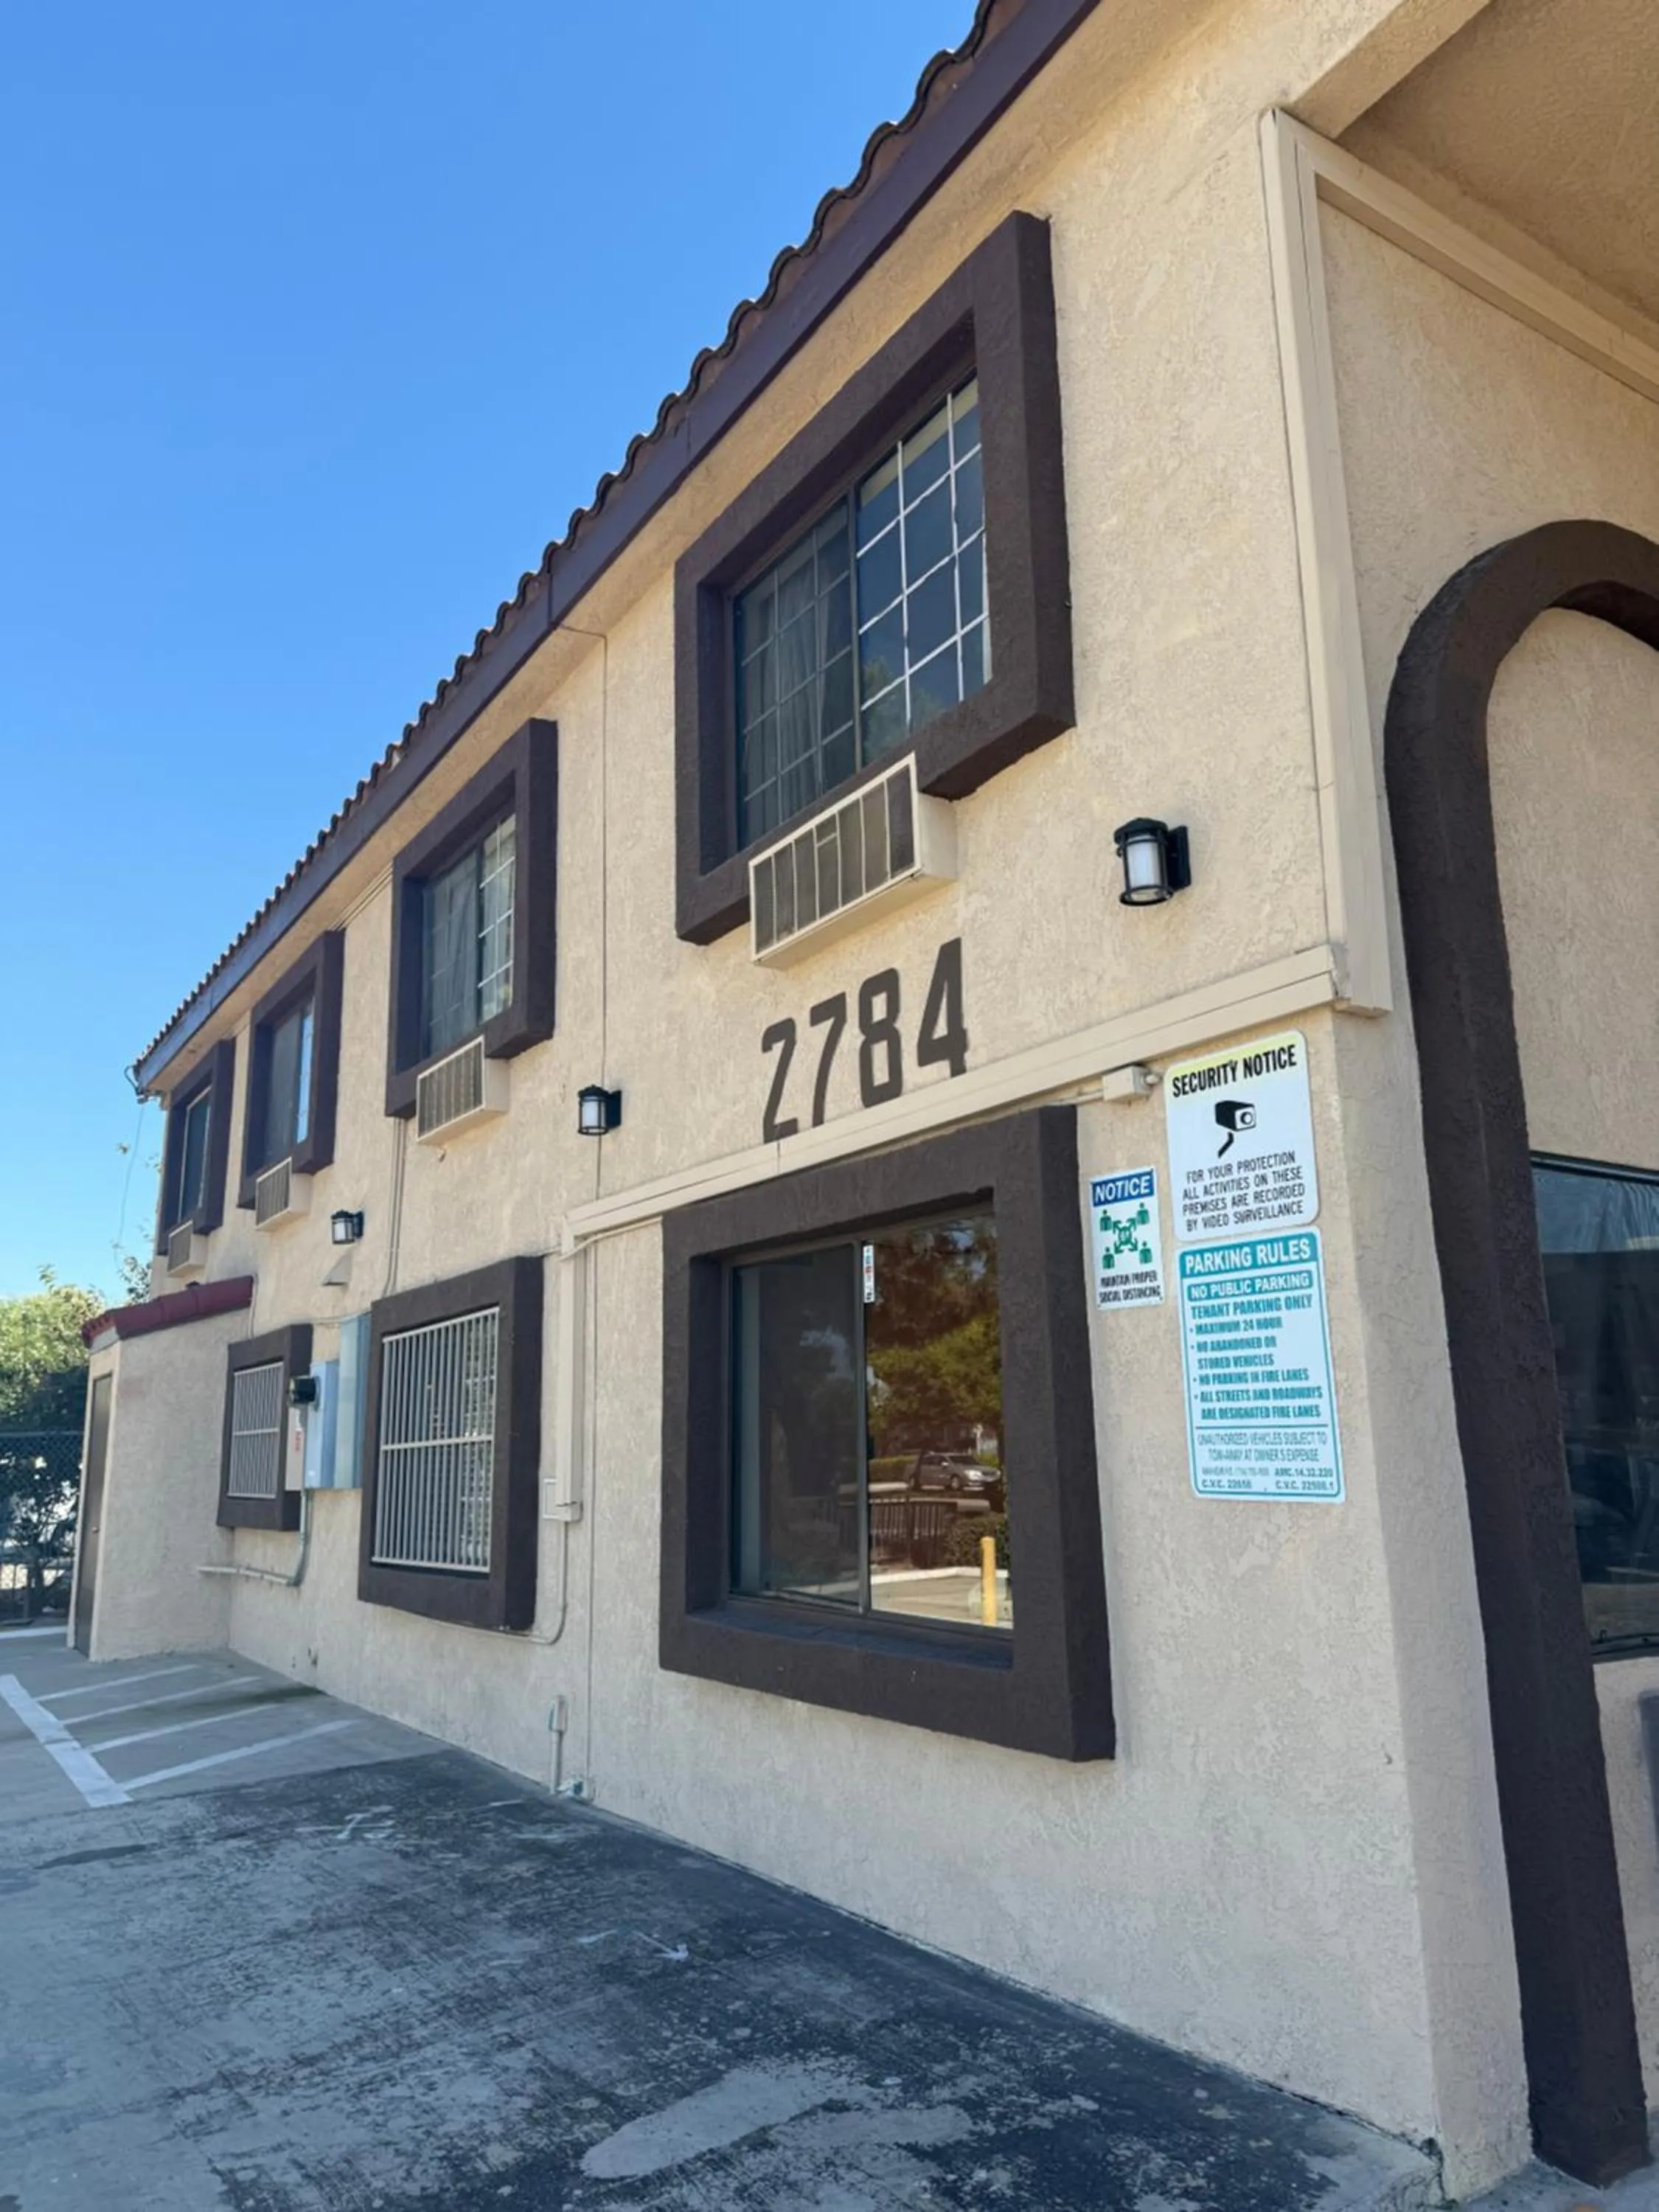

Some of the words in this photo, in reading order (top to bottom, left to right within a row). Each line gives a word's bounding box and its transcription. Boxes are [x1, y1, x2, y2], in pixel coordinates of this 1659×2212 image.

[762, 936, 970, 1144] 2784
[1172, 1060, 1239, 1097] SECURITY
[1243, 1044, 1297, 1079] NOTICE
[1186, 1169, 1203, 1185] FOR
[1208, 1163, 1233, 1180] YOUR
[1237, 1150, 1295, 1173] PROTECTION
[1095, 1175, 1150, 1203] NOTICE
[1183, 1188, 1197, 1202] ALL
[1203, 1177, 1251, 1197] ACTIVITIES
[1253, 1172, 1268, 1186] ON
[1272, 1166, 1304, 1183] THESE
[1183, 1198, 1227, 1217] PREMISES
[1231, 1193, 1250, 1208] ARE
[1253, 1183, 1305, 1203] RECORDED
[1186, 1219, 1197, 1232] BY
[1201, 1214, 1230, 1229] VIDEO
[1234, 1201, 1304, 1226] SURVEILLANCE
[1185, 1245, 1252, 1274] PARKING
[1256, 1239, 1311, 1264] RULES
[1132, 1270, 1158, 1283] PROPER
[1191, 1285, 1207, 1299] NO
[1210, 1280, 1251, 1296] PUBLIC
[1255, 1273, 1310, 1291] PARKING
[1099, 1291, 1121, 1304] SOCIAL
[1122, 1286, 1161, 1301] DISTANCING
[1191, 1302, 1230, 1319] TENANT
[1233, 1298, 1282, 1315] PARKING
[1284, 1293, 1312, 1309] ONLY
[1195, 1321, 1239, 1335] MAXIMUM
[1242, 1319, 1254, 1332] 24
[1256, 1316, 1282, 1329] HOUR
[1197, 1340, 1208, 1353] NO
[1210, 1338, 1262, 1352] ABANDONED
[1264, 1335, 1277, 1348] OR
[1197, 1357, 1231, 1370] STORED
[1232, 1353, 1274, 1368] VEHICLES
[1198, 1373, 1211, 1385] NO
[1212, 1371, 1248, 1385] PARKING
[1251, 1371, 1260, 1383] IN
[1262, 1370, 1280, 1383] FIRE
[1281, 1368, 1310, 1381] LANES
[1200, 1391, 1214, 1403] ALL
[1215, 1389, 1251, 1402] STREETS
[1253, 1388, 1270, 1401] AND
[1272, 1386, 1324, 1400] ROADWAYS
[1201, 1407, 1217, 1420] ARE
[1219, 1405, 1270, 1419] DESIGNATED
[1272, 1405, 1292, 1419] FIRE
[1293, 1405, 1321, 1418] LANES
